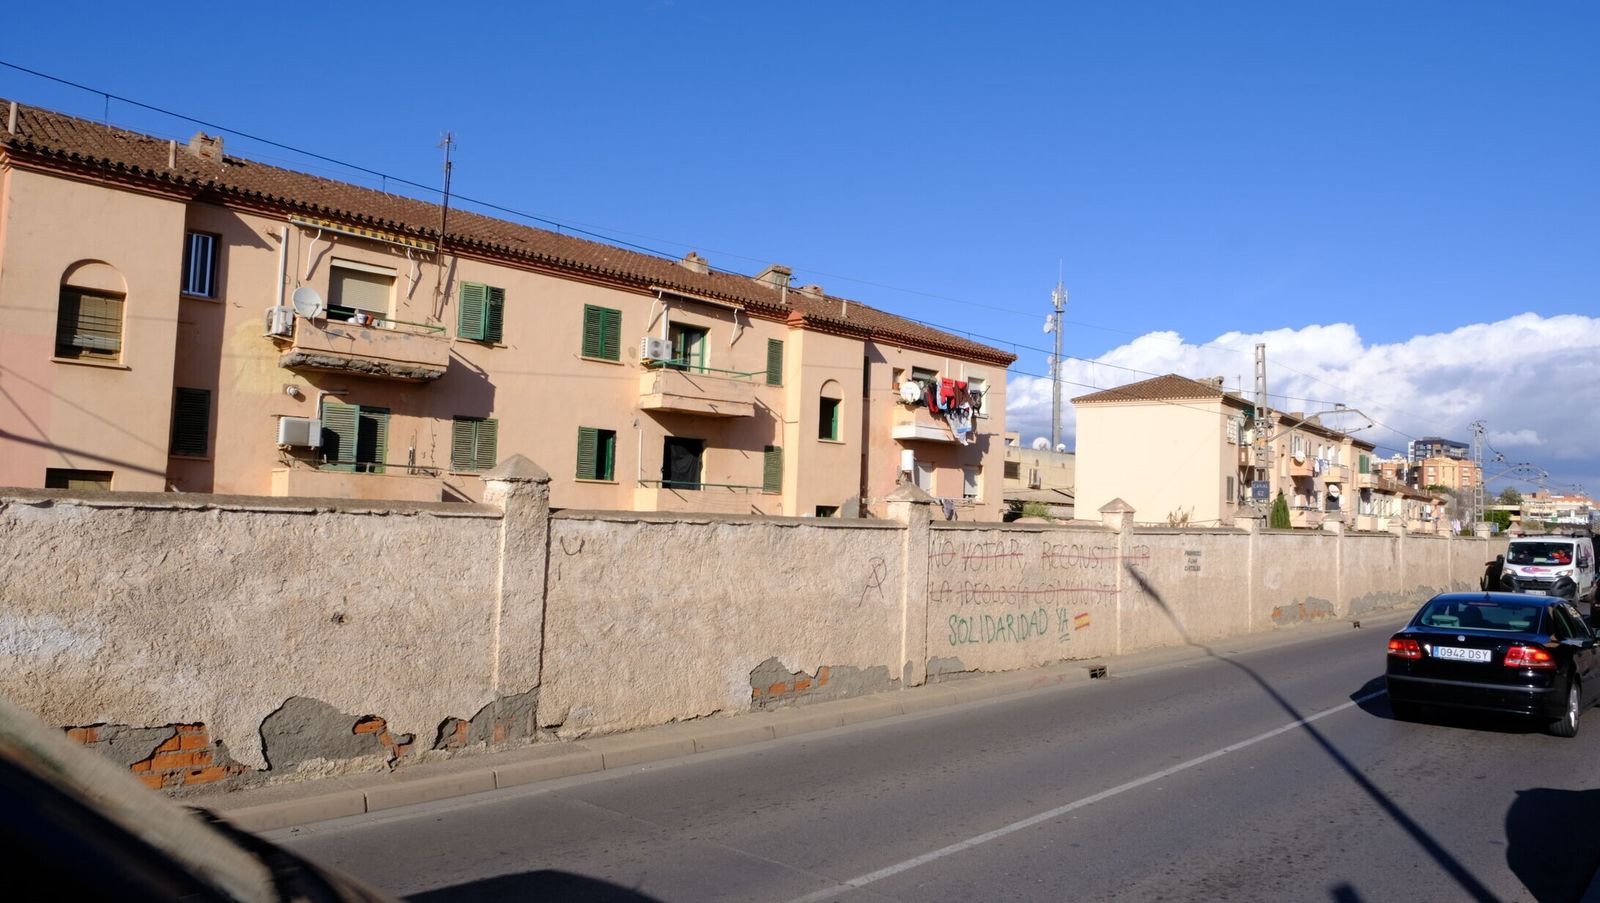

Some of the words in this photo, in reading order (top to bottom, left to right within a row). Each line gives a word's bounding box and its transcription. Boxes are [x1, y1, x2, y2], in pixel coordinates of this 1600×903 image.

[930, 540, 955, 569] NO
[930, 580, 952, 602] LA
[948, 608, 1048, 646] SOLIDARIDAD
[1056, 607, 1069, 633] YA
[1440, 647, 1465, 658] 0942
[1468, 649, 1489, 660] DSY
